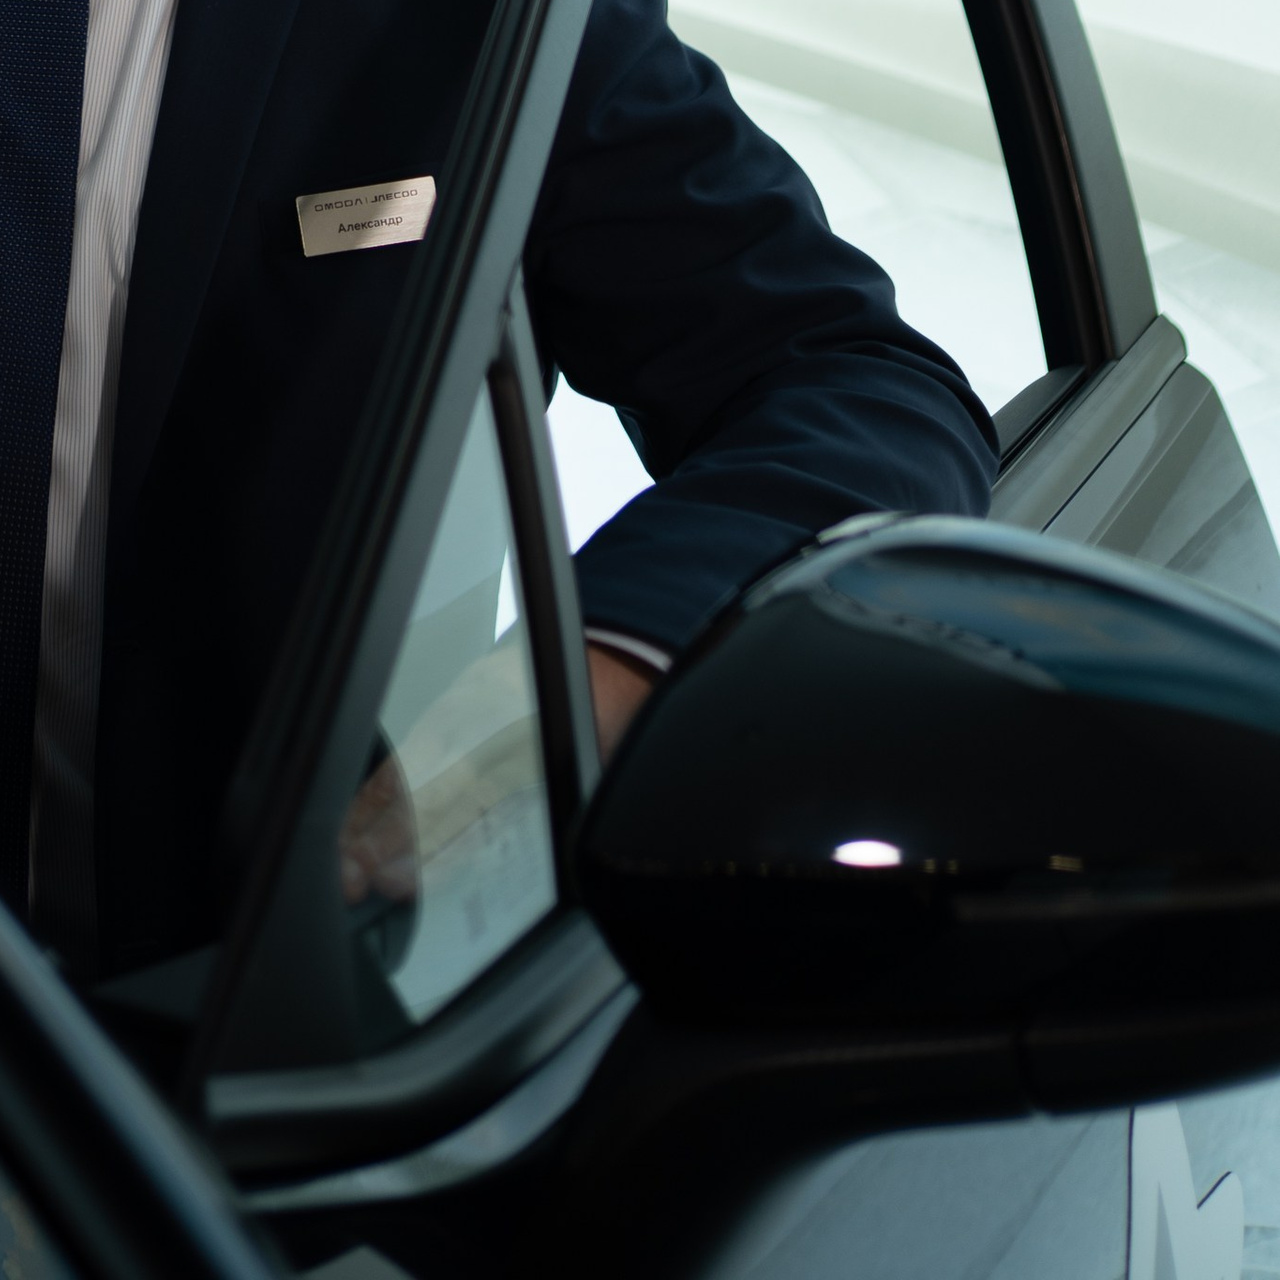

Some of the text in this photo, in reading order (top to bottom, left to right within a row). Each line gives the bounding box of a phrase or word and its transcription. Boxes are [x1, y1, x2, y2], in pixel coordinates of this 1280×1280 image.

[314, 189, 418, 212] OMODA JAECOO
[338, 216, 403, 233] Александр
